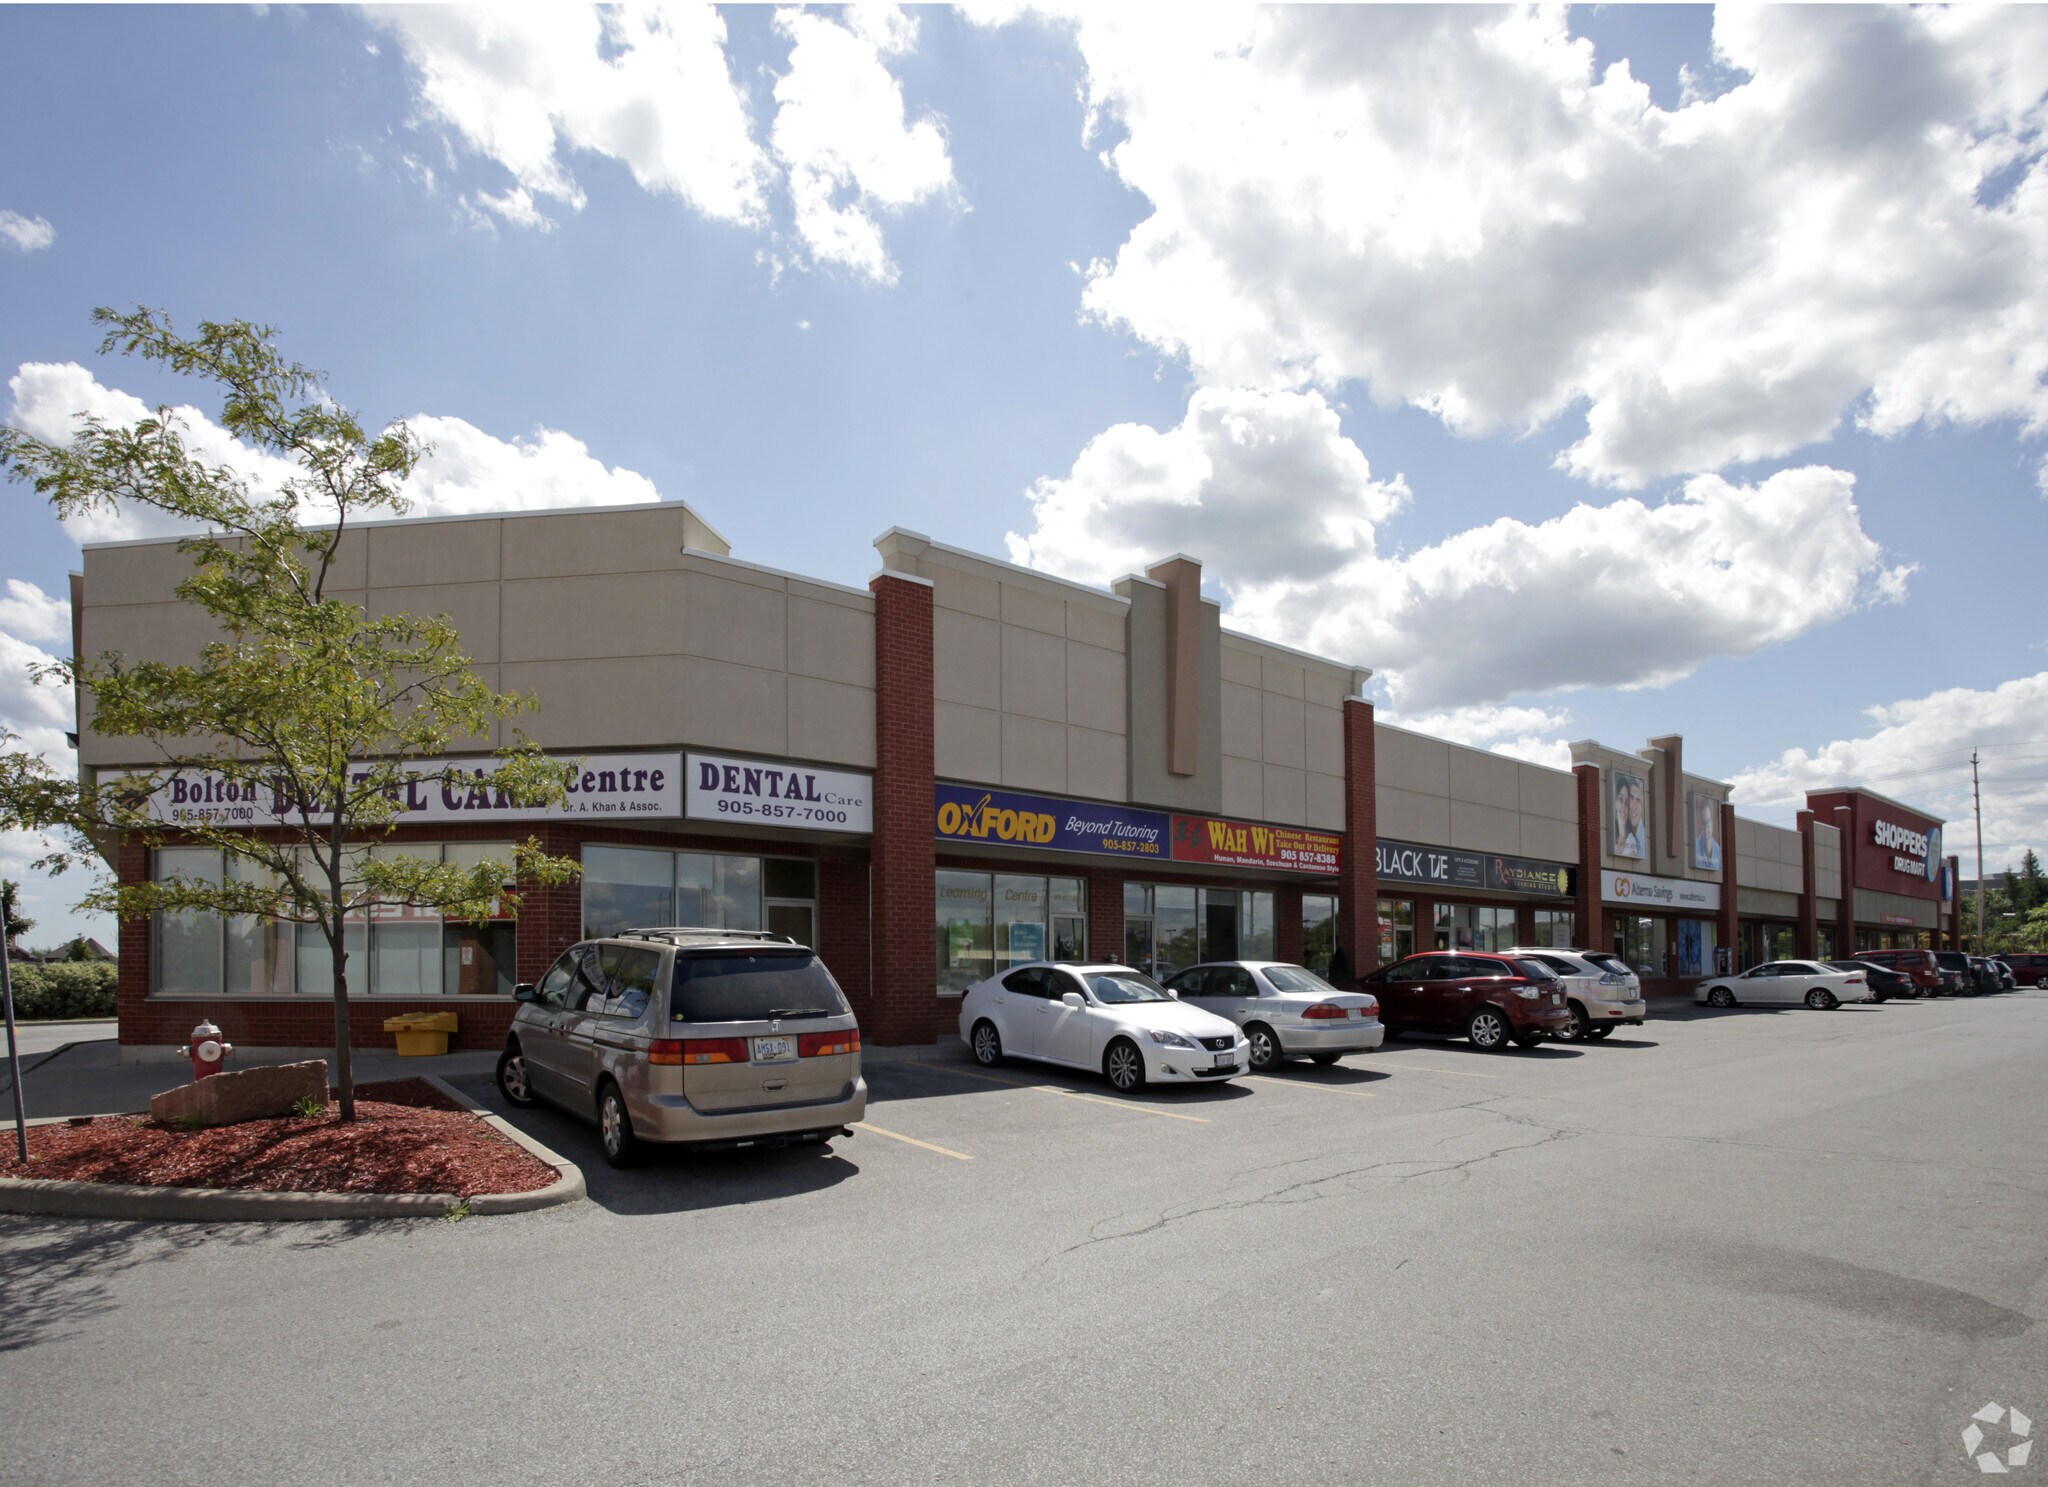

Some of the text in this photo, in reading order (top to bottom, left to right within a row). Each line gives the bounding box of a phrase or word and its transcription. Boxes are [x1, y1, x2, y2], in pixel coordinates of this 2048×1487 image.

[172, 765, 664, 814] Bolton DAL CA Centre
[699, 762, 863, 807] DENTAL Care
[172, 807, 253, 821] 95-8577000
[579, 802, 588, 812] A.
[592, 802, 616, 812] Khan
[620, 801, 626, 811] &
[629, 801, 662, 811] Assoc.
[717, 799, 847, 823] 905-857-7000
[937, 794, 1056, 843] OXFORD
[1065, 816, 1113, 836] Beyond
[1112, 821, 1159, 843] Tutoring
[1102, 838, 1160, 854] 905-857-2803
[1207, 821, 1247, 853] WAH
[1251, 826, 1275, 856] WI
[1275, 829, 1339, 845] Chinese Restaurant
[1276, 840, 1340, 855] Take Out & Delivery
[1875, 819, 1928, 857] SHOPPERS
[1214, 853, 1340, 874] Hunan, Mandarin, Szechuan & Cantonese Style
[1281, 849, 1336, 864] 905 857-8388
[1376, 847, 1448, 879] BLACK TIE
[1894, 855, 1925, 876] DRUG MART
[1495, 858, 1556, 884] RAYDIANCE
[940, 886, 988, 903] Learning
[1005, 888, 1038, 902] Centre
[1653, 885, 1673, 902] Savings
